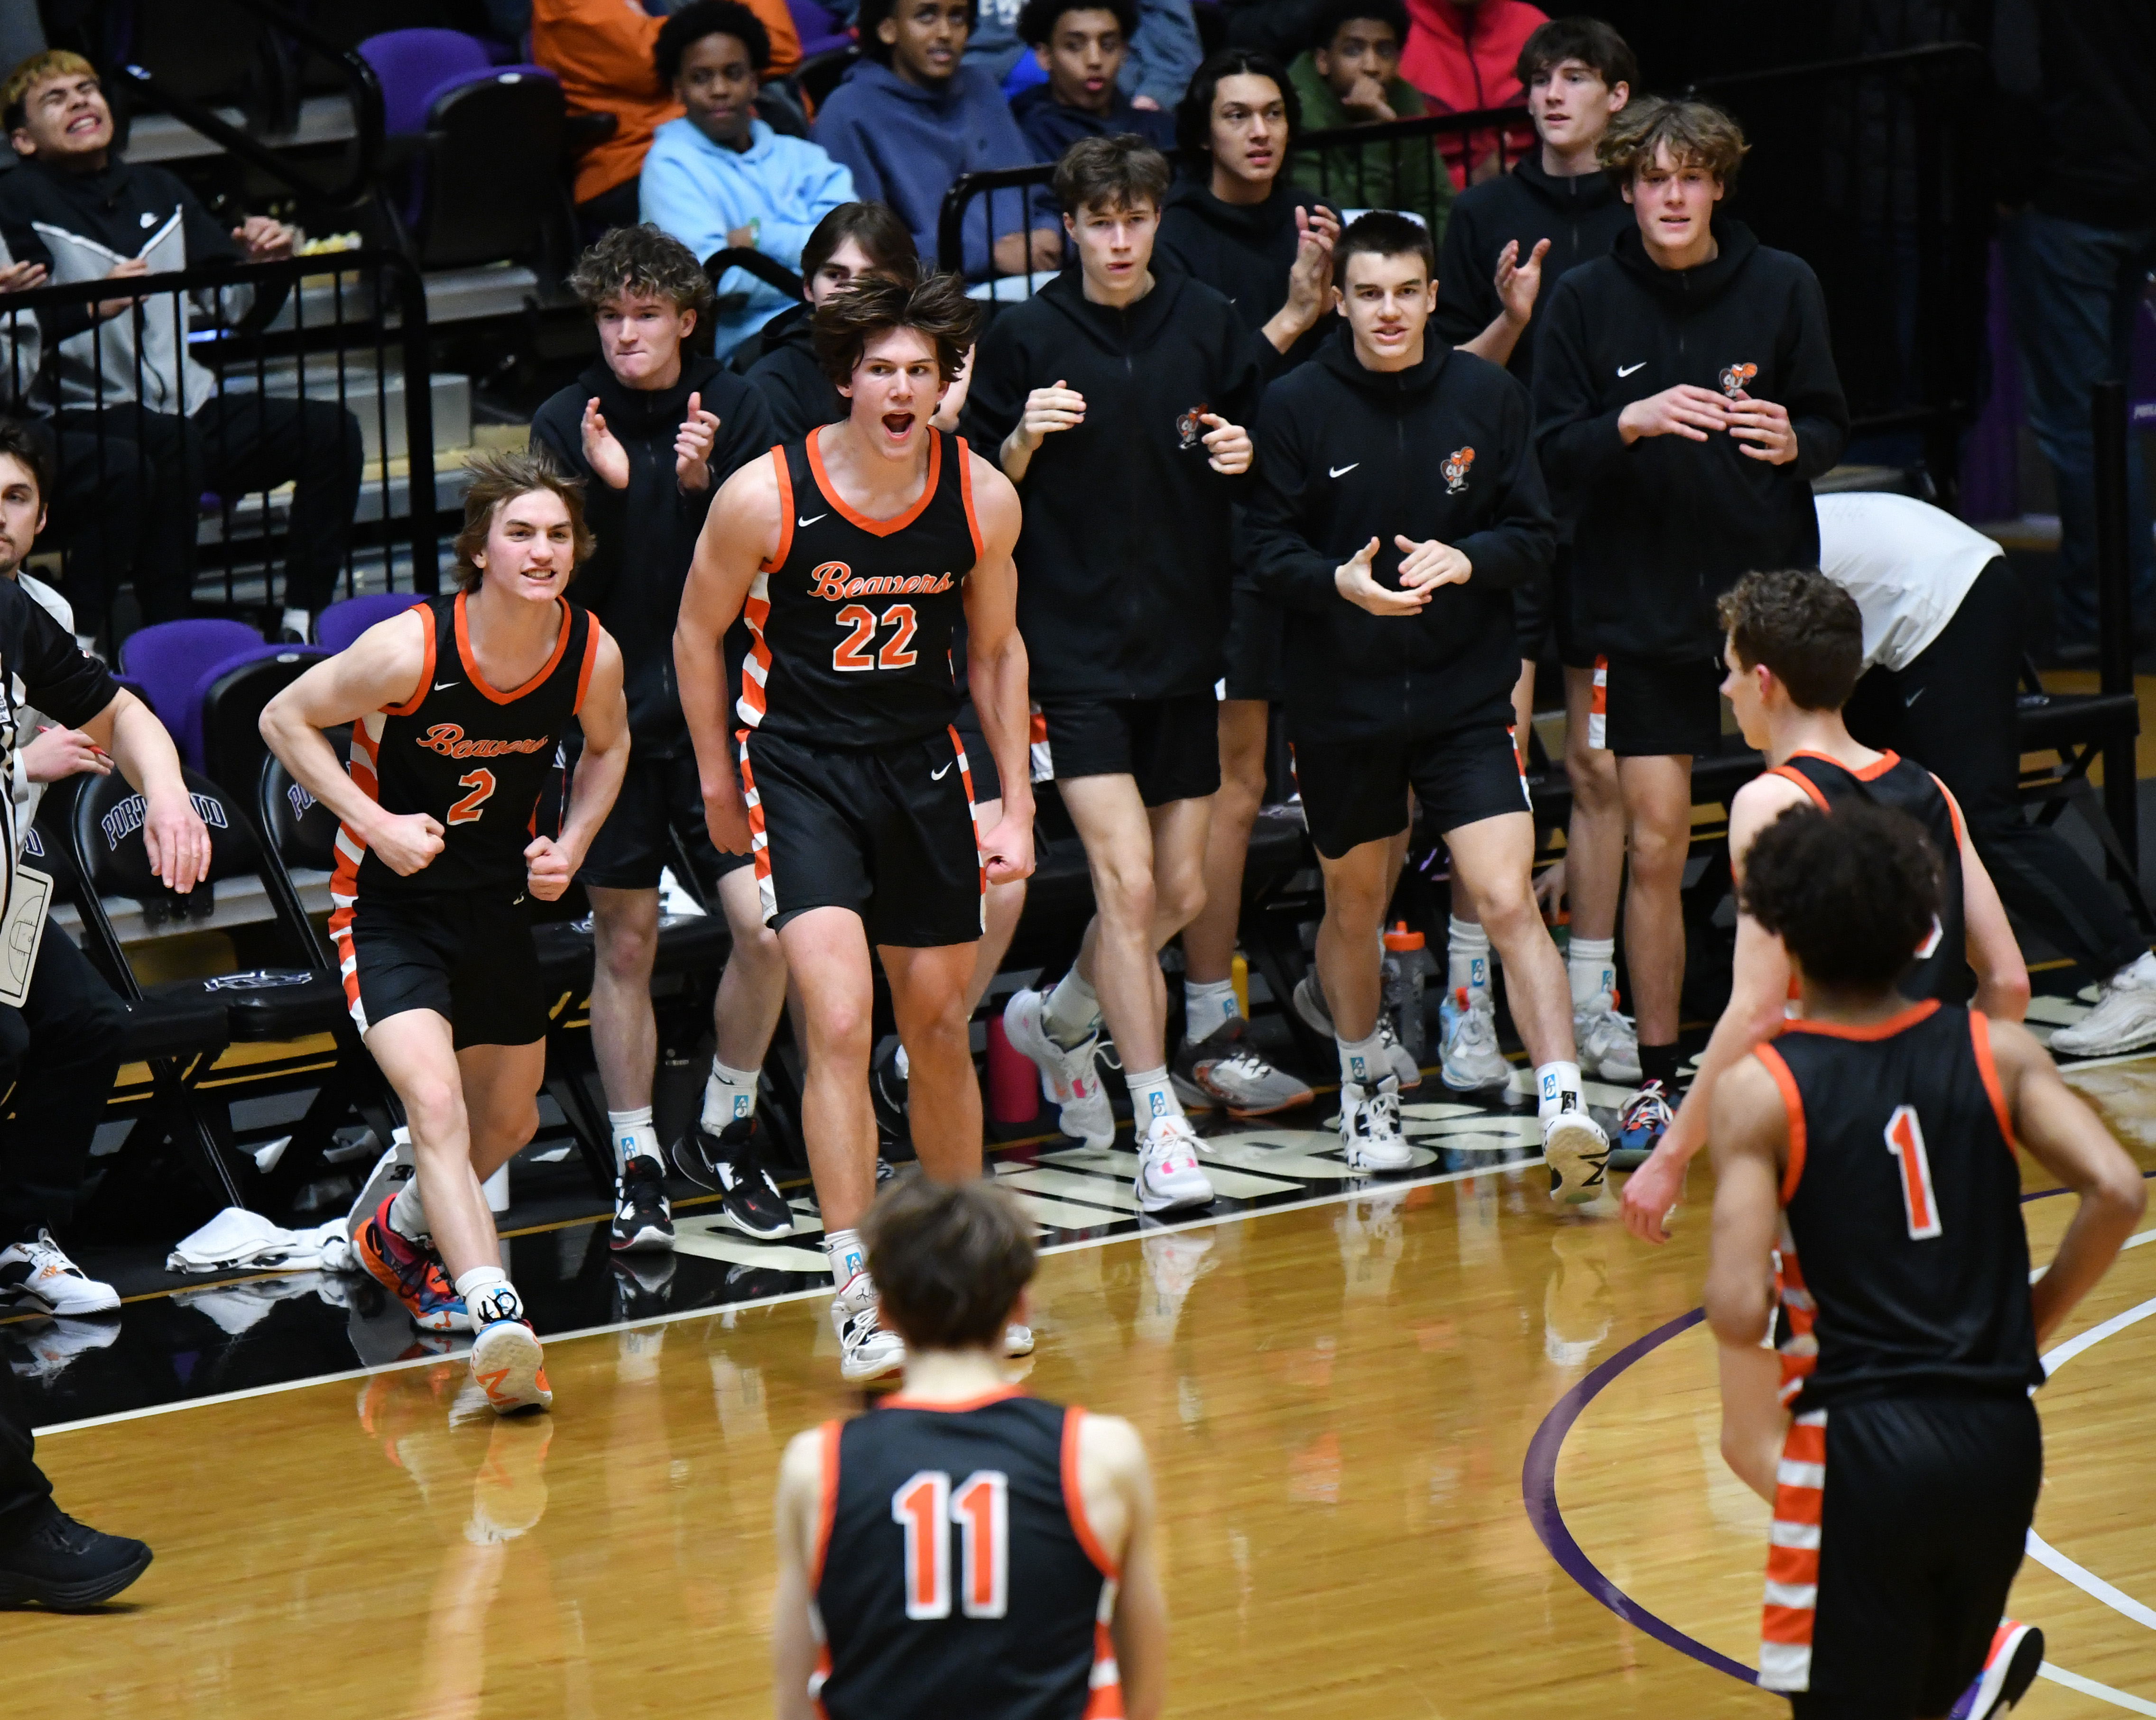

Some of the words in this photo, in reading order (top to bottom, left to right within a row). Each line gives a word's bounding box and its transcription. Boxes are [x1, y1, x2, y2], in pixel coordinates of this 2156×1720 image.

[807, 561, 954, 601] Beavers
[833, 604, 918, 672] 22
[416, 723, 548, 759] Beavers
[446, 767, 496, 826] 2
[1883, 1104, 1943, 1242] 1
[891, 1469, 1010, 1620] 11
